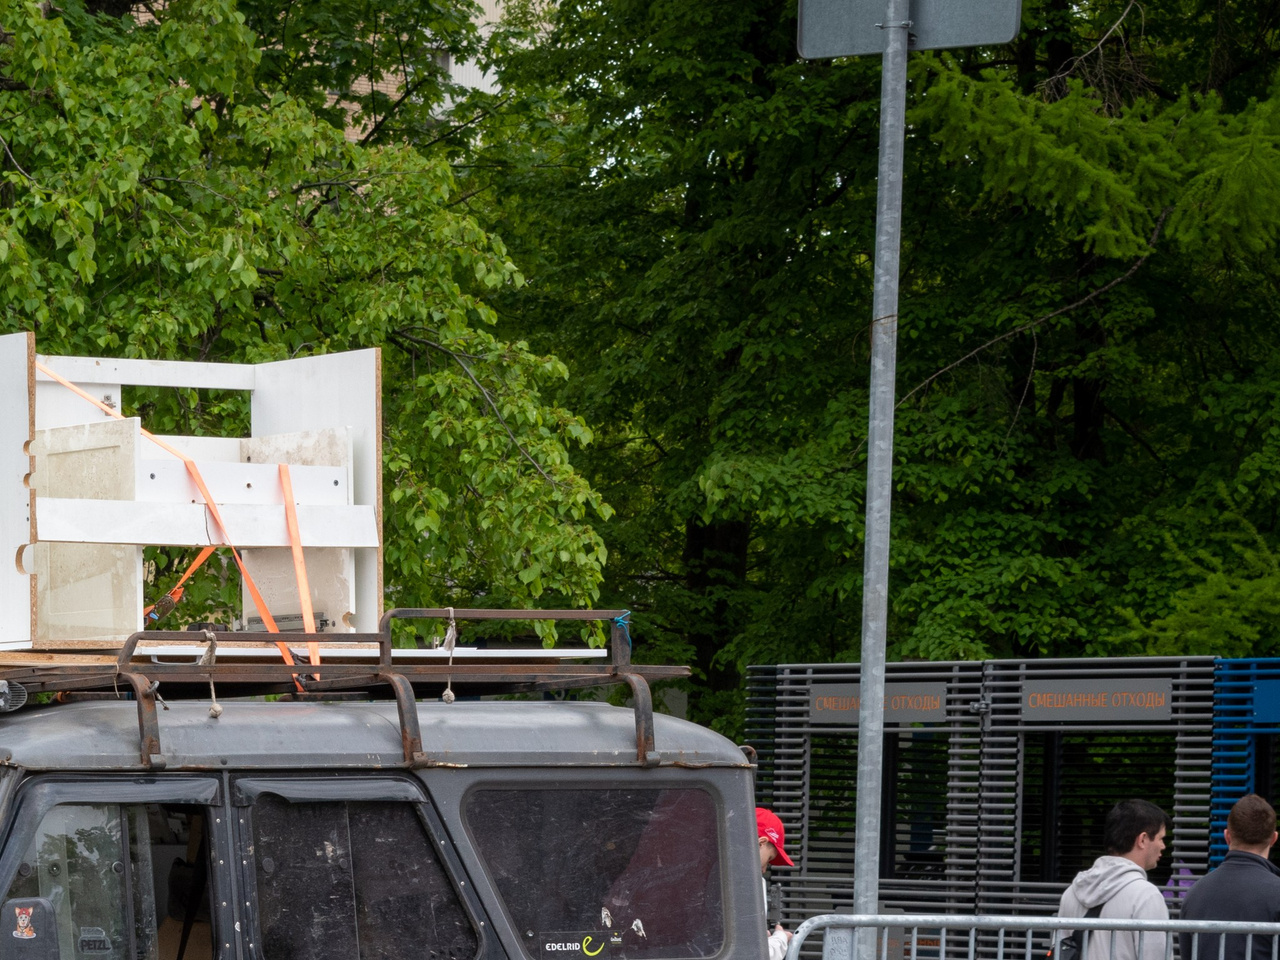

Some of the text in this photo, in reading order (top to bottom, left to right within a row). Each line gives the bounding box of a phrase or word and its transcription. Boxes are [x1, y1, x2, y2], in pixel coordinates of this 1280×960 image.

[815, 694, 940, 712] СМЕШАЕ ОТХОДЫ
[1028, 690, 1166, 710] СМЕШАННЫЕ ОТХОДЫ
[80, 939, 111, 952] PETZL
[545, 942, 581, 951] EDELRID
